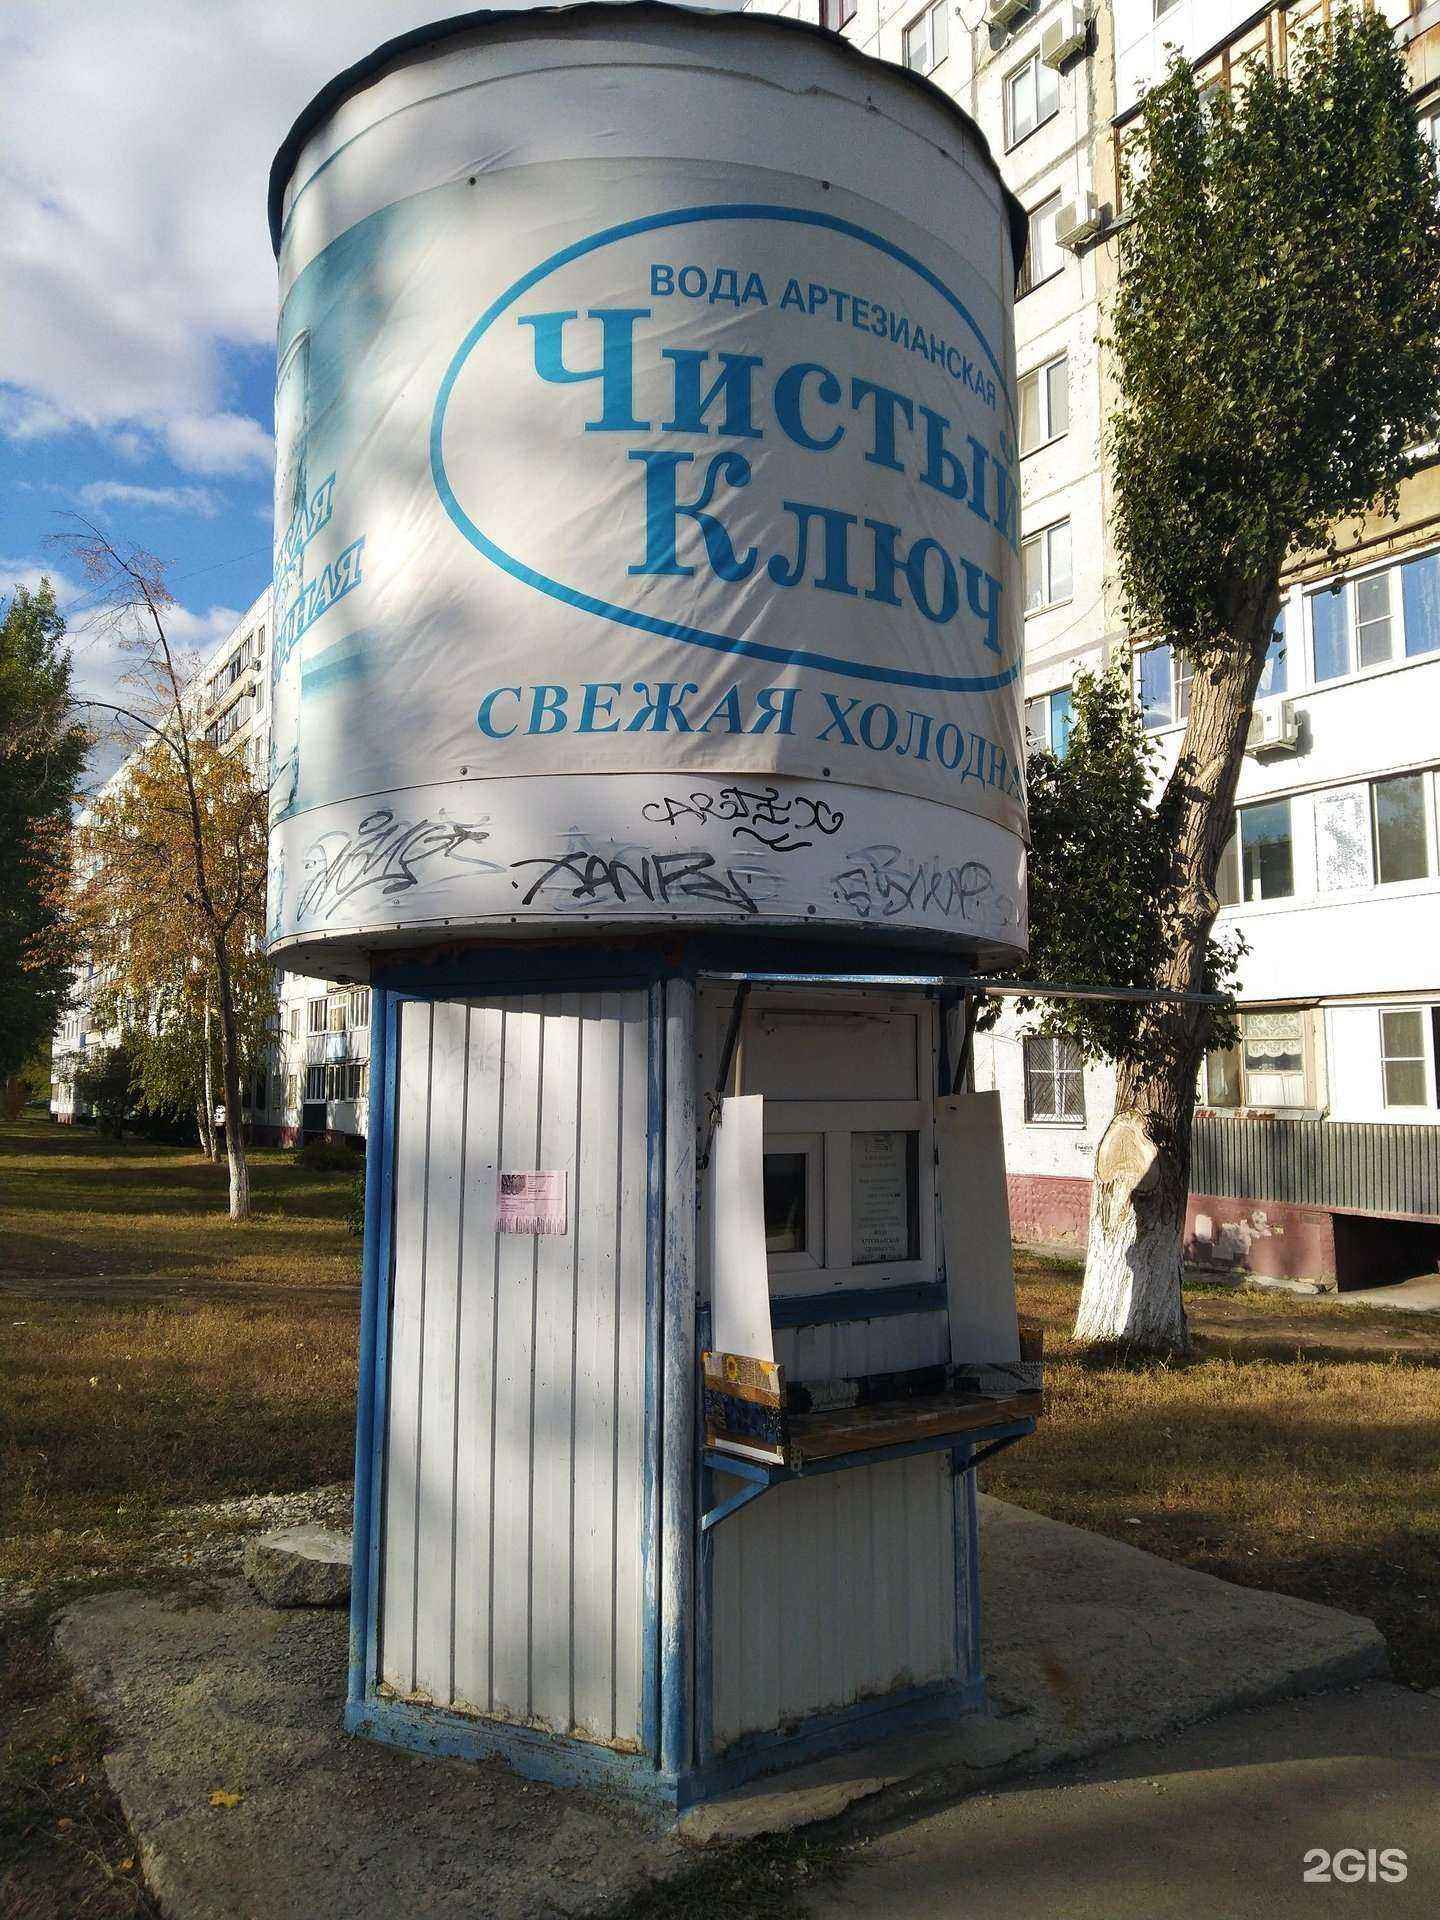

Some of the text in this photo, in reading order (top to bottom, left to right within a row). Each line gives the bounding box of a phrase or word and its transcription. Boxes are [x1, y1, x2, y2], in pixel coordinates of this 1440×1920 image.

[649, 263, 997, 411] ВОДА АРТЕЗИАНСКАЯ
[627, 450, 1004, 655] Ключ
[475, 681, 803, 738] СВЕЖАЯ
